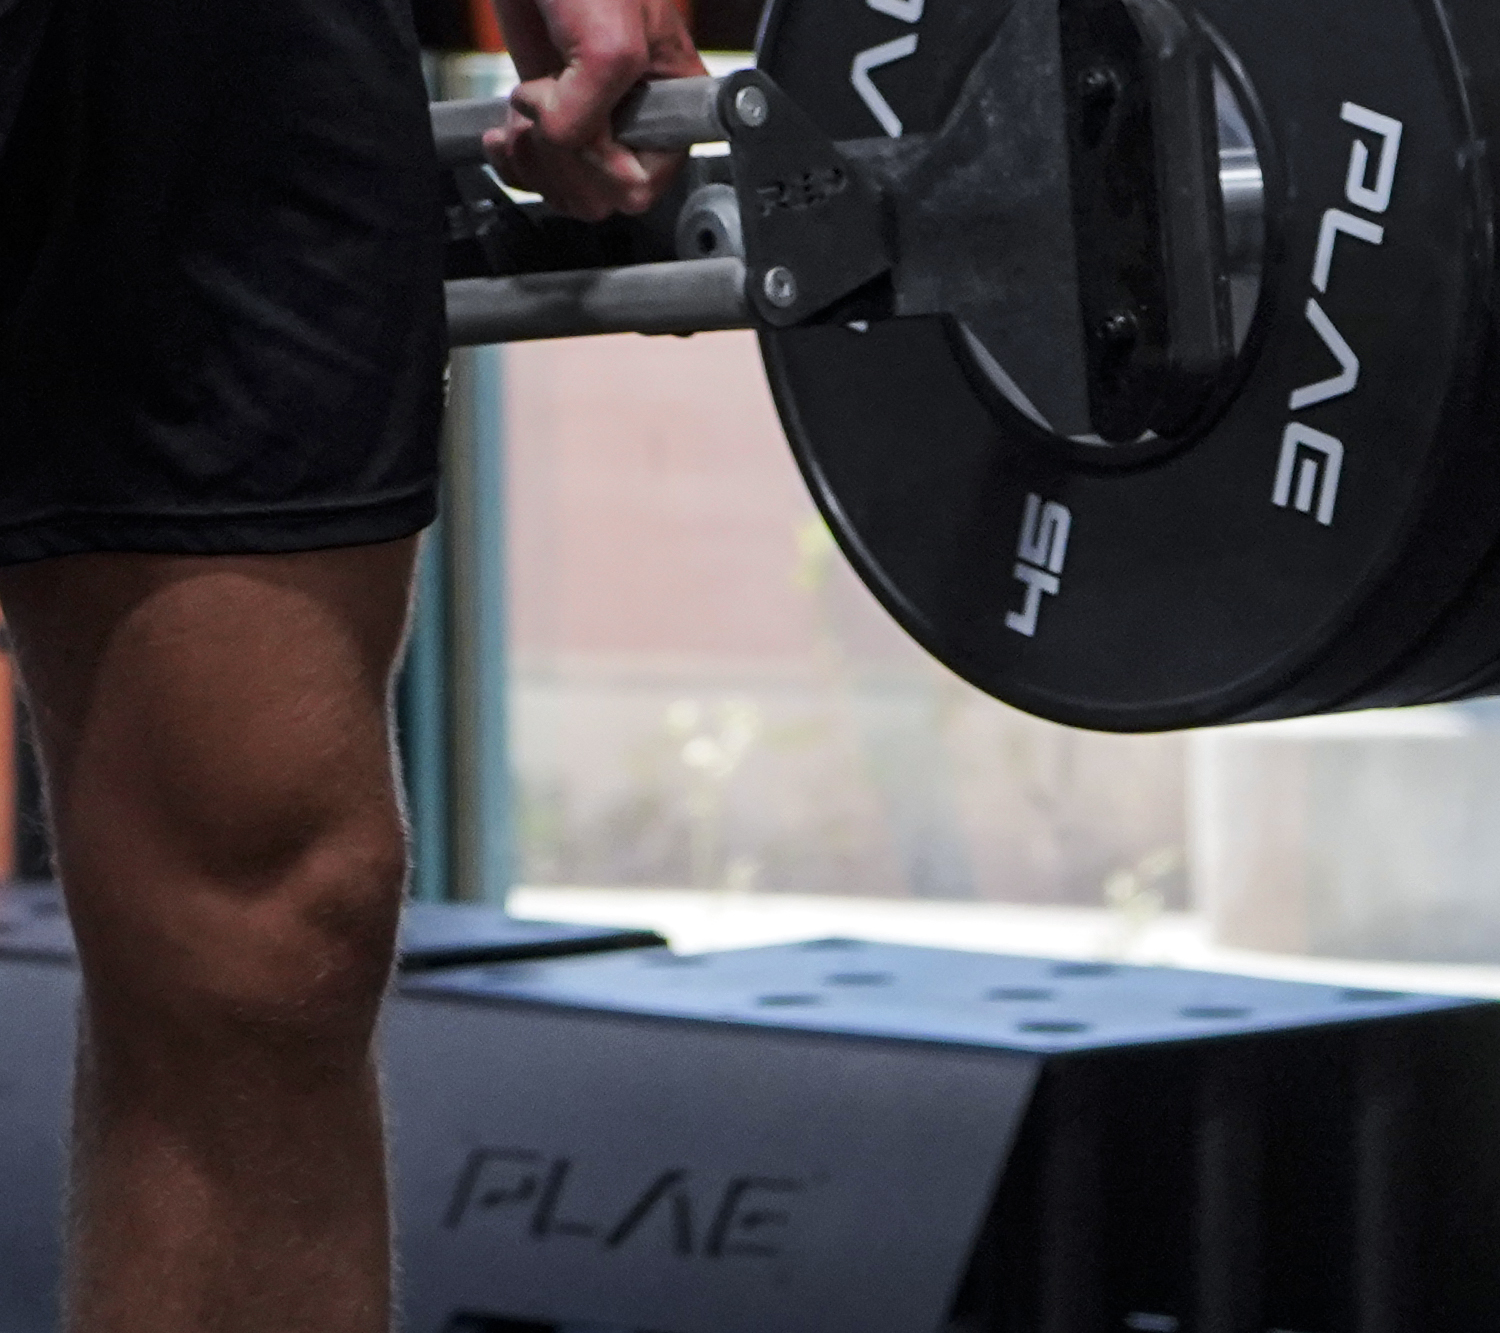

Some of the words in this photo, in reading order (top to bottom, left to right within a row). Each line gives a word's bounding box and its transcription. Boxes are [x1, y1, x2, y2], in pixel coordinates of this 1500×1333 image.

[1272, 101, 1402, 525] PLAE
[1005, 493, 1071, 637] 45
[444, 1145, 800, 1259] PLAE
